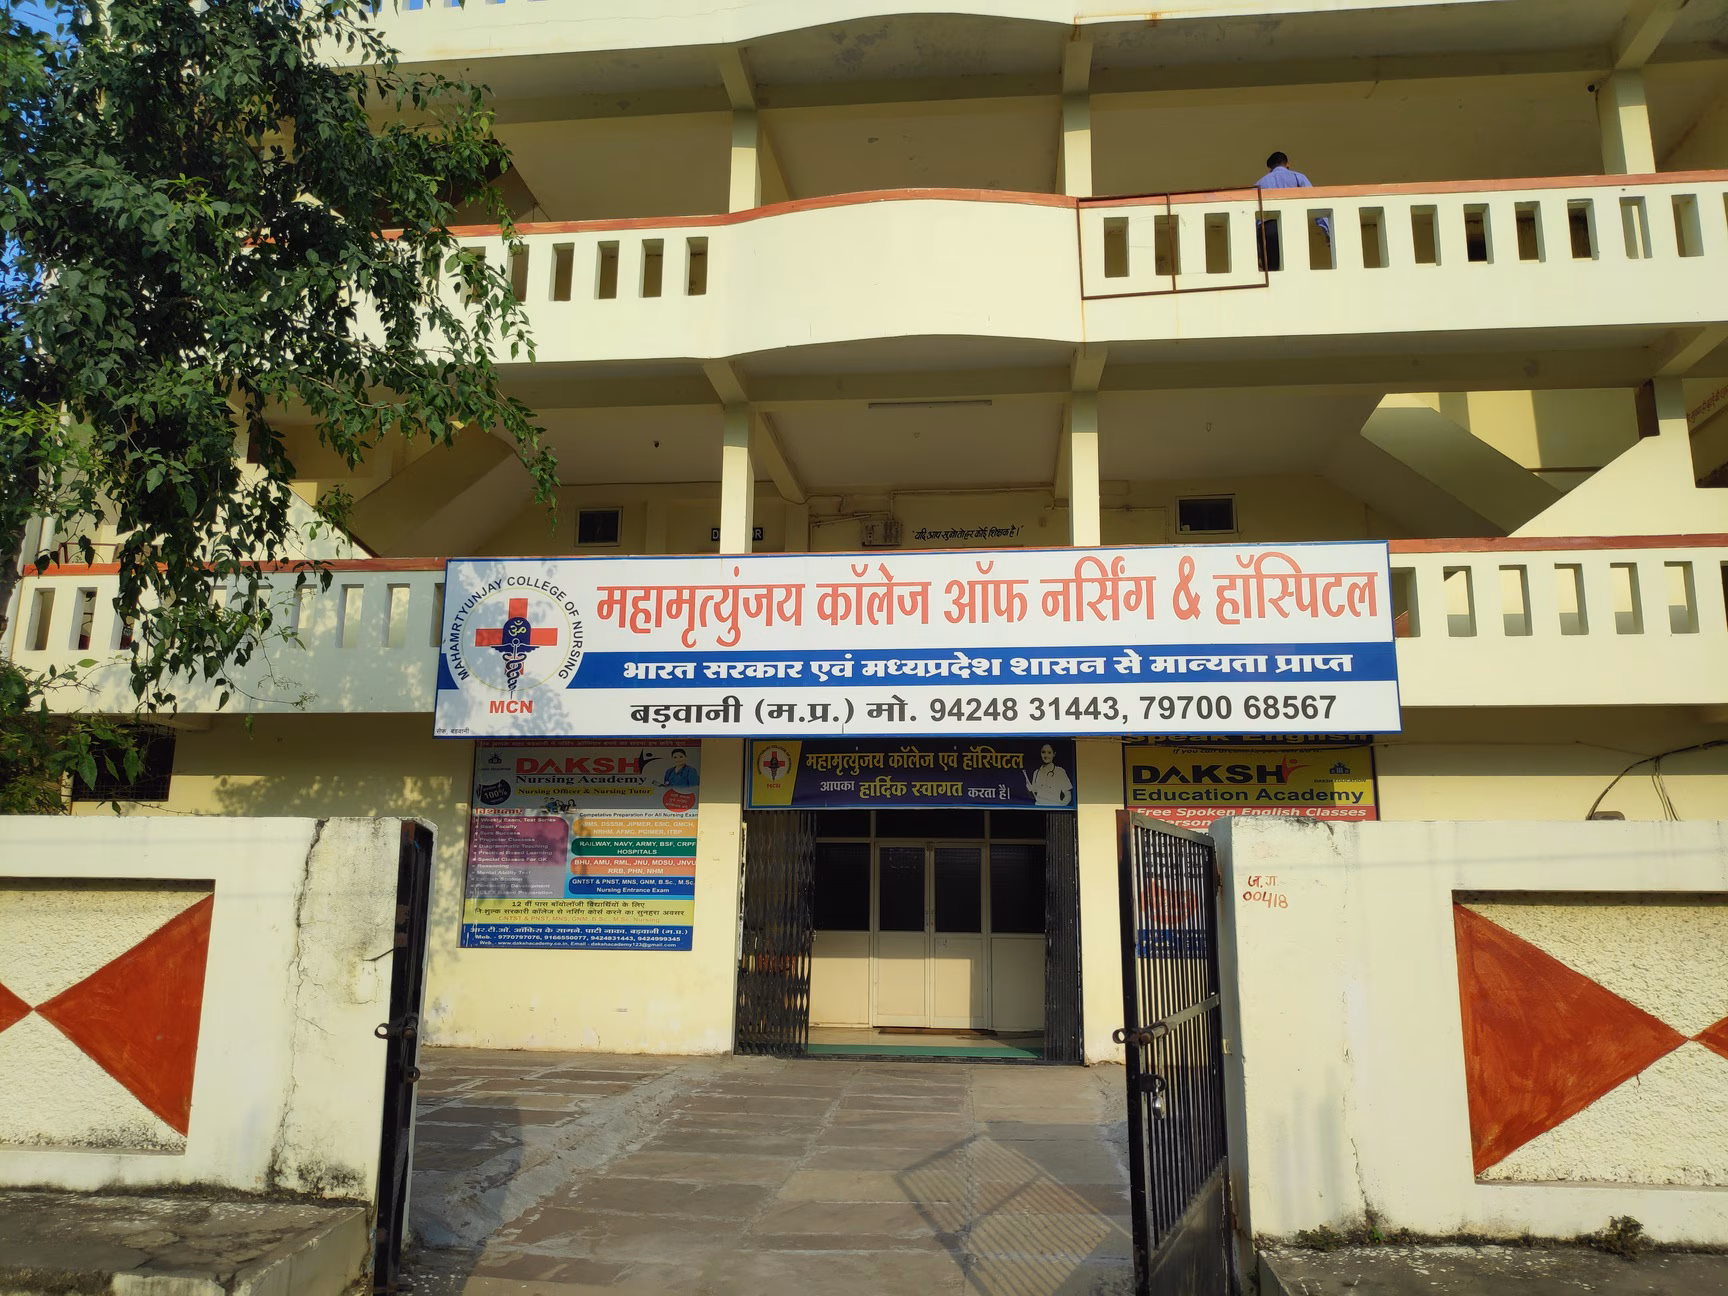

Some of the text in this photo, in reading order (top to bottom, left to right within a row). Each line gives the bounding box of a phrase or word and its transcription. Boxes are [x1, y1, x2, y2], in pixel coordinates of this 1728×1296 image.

[597, 551, 1378, 648] महामृत्युंजय कॉलेज ऑफ नर्सिंग & हॉस्पिटल
[449, 576, 584, 681] MAHAMRTYUNJAY COLLEGE OF NURSING
[623, 649, 1354, 683] भारत सरकार एवं मध्यप्रदेश शासन से मान्यता प्राप्त
[489, 700, 533, 714] MCN
[630, 694, 1338, 729] बड़वानी (म.प्र.) मो. 94248 31443, 79700 68567
[516, 757, 642, 774] DAKSH
[805, 746, 884, 777] महामृत्युंजय
[888, 745, 935, 768] कॉलेज
[938, 746, 958, 770] एवं
[962, 744, 1024, 770] हॉस्पिटल
[516, 775, 647, 785] Nursing Academy
[1132, 764, 1284, 785] DAKSH
[820, 780, 855, 793] आपका
[859, 775, 907, 799] हार्दिक
[911, 781, 963, 798] स्वागत
[967, 786, 996, 799] करता
[1132, 788, 1364, 804] Education Academy
[1175, 807, 1237, 818] Spoken
[1305, 807, 1367, 817] Classes
[1242, 891, 1288, 909] 00418
